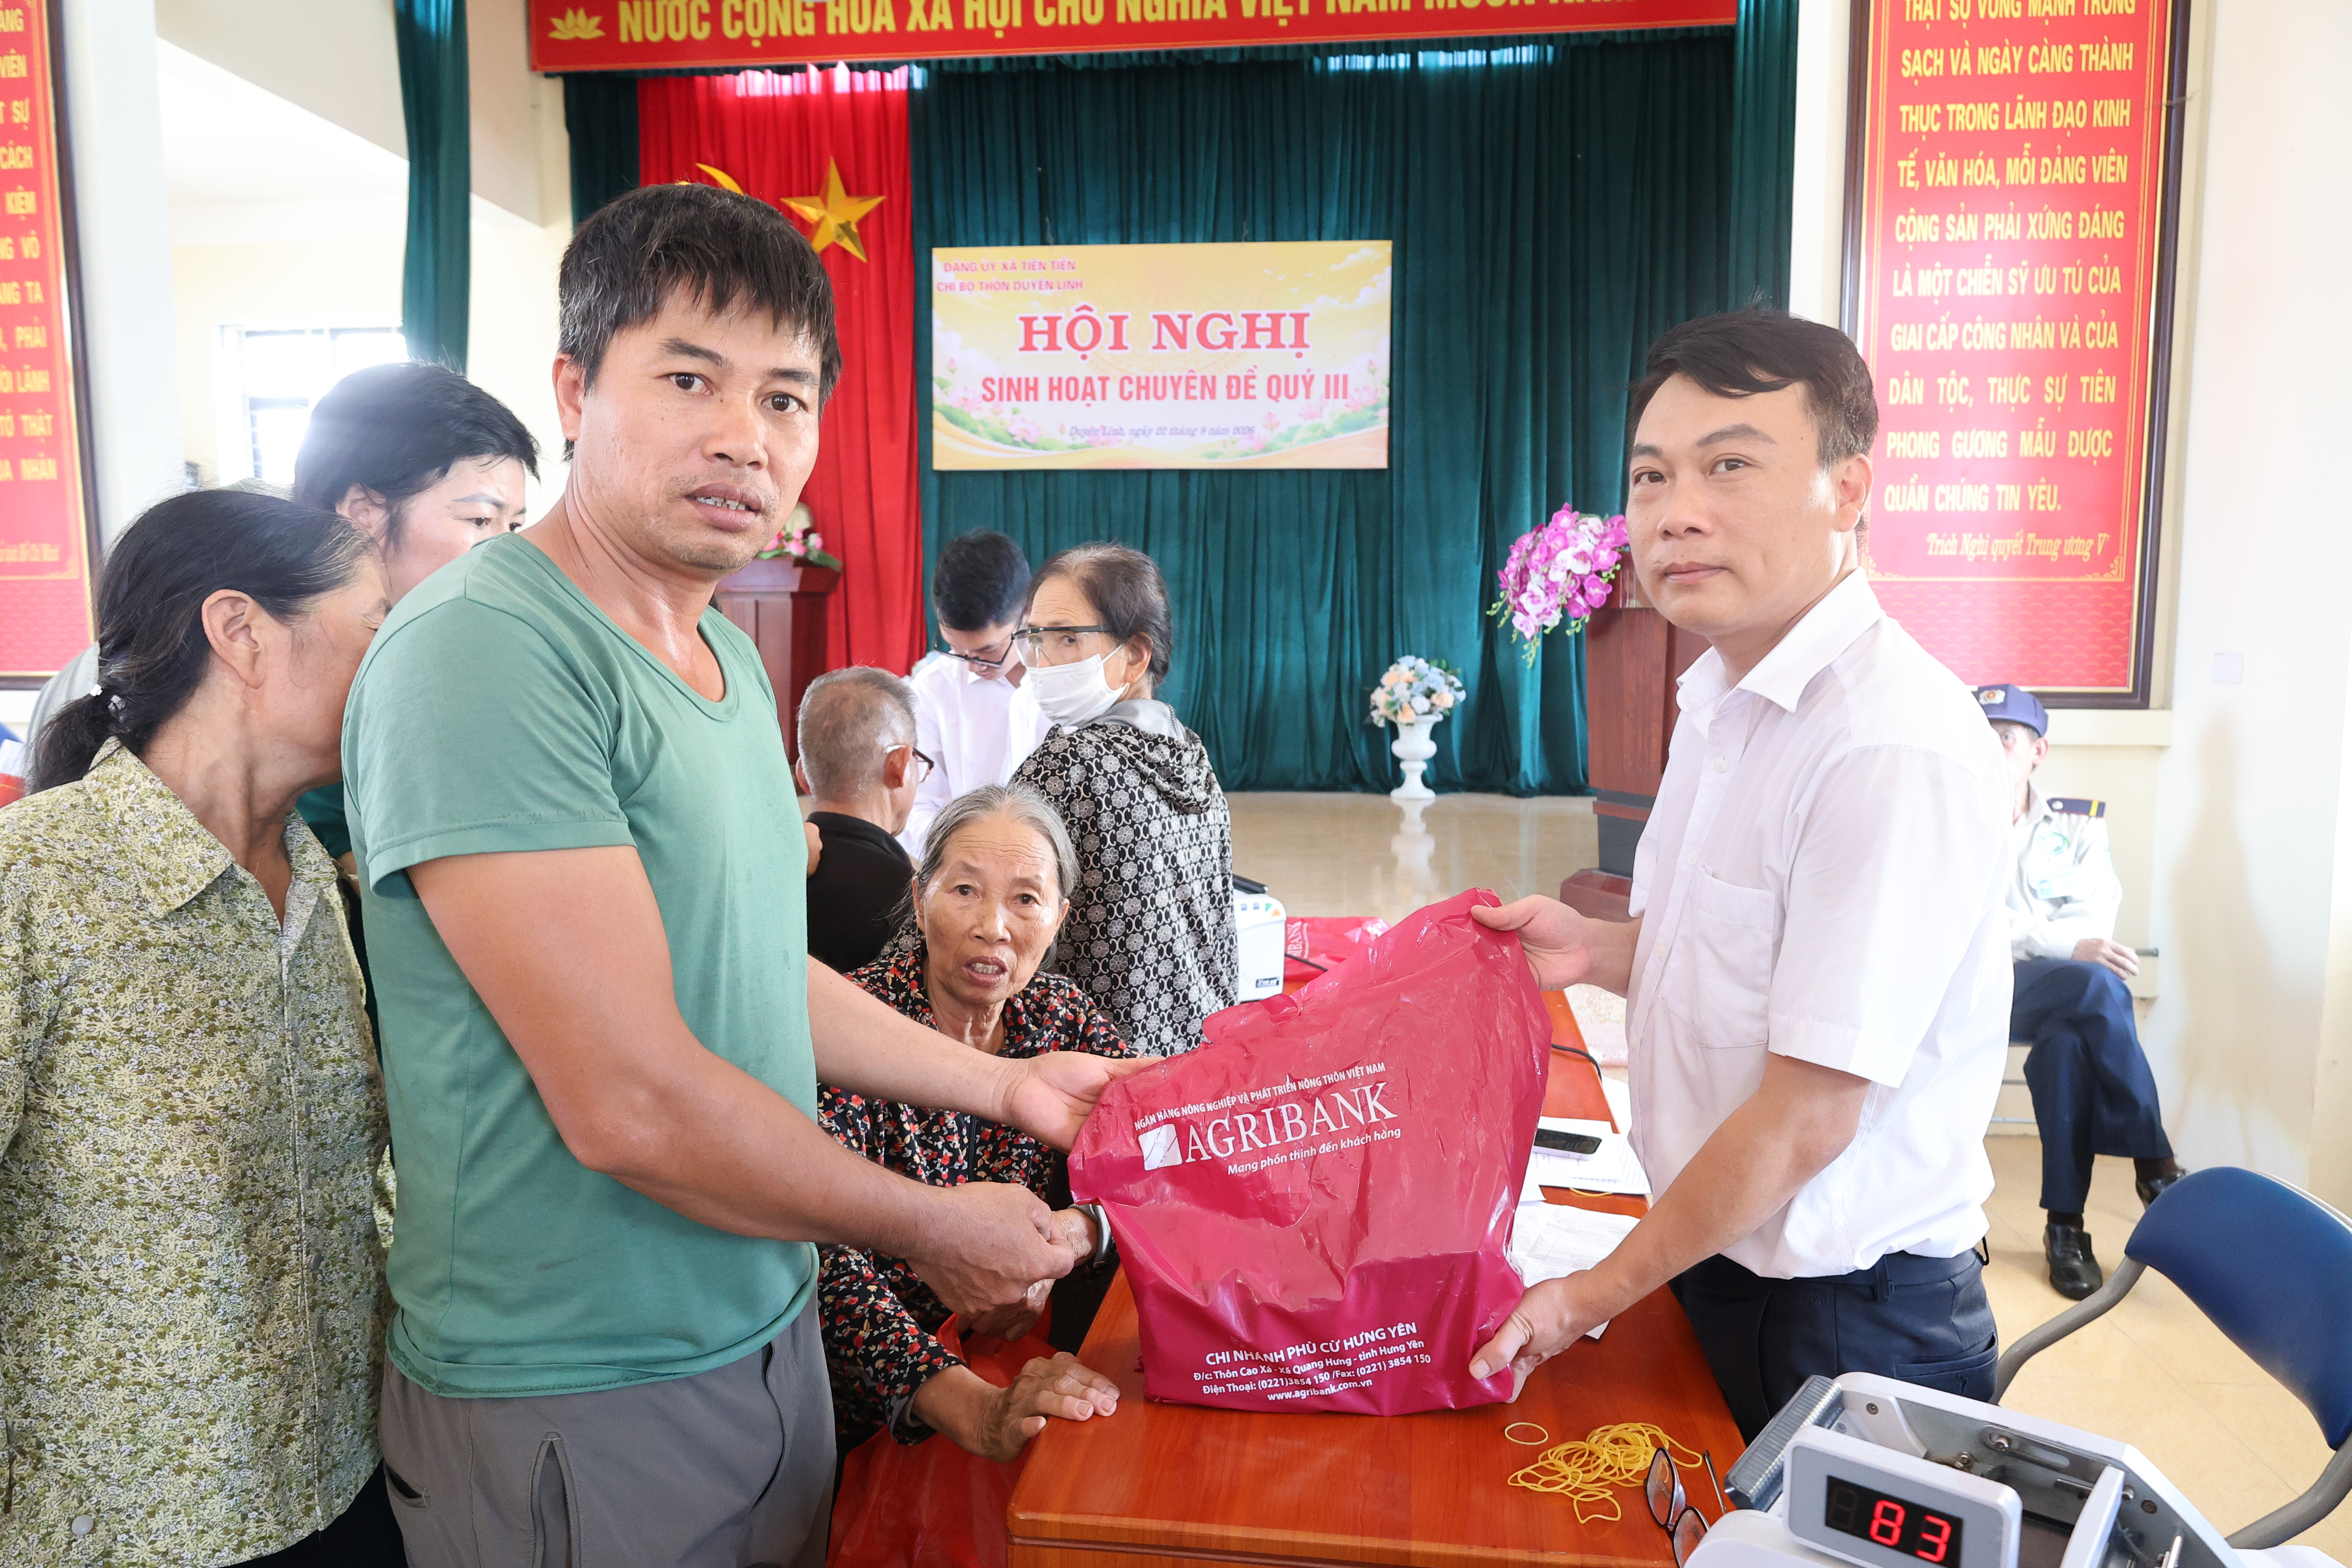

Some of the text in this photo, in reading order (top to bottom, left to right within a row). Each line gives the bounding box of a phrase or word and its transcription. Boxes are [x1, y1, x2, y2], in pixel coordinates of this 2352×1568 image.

[1901, 35, 2134, 85] SẠCH VÀ NGÀY CÀNG THÀNH
[1900, 94, 2131, 141] THỤC TRONG LÃNH ĐẠO KINH
[1898, 143, 2129, 191] TẾ, VĂN HÓA, MỖI ĐẢNG VIÊN
[1895, 201, 2125, 251] CỘNG SẢN PHẢI XỨNG ĐÁNG
[25, 281, 44, 303] TA
[937, 281, 956, 291] CHI
[1057, 279, 1083, 290] LINH
[1893, 261, 1913, 297] LÀ
[1918, 261, 1952, 305] MỘT
[2008, 260, 2029, 295] SỸ
[2034, 263, 2057, 294] ƯU
[2062, 259, 2083, 294] TÚ
[2088, 253, 2122, 294] CỦA
[1018, 304, 1310, 361] HỘI NGHỊ
[1891, 309, 2119, 351] GIAI CẤP CÔNG NHÂN VÀ CỦA
[982, 365, 1348, 407] SINH HOẠT CHUYÊN ĐỀ QUÝ III
[1889, 368, 2116, 412] DÂN TỘC, THỰC SỰ TIÊN
[1886, 417, 2113, 466] PHONG GƯƠNG MẪU ĐƯỢC
[1884, 474, 2061, 512] QUẦN CHÚNG TIN YÊU.
[1959, 532, 1990, 562] Nghị
[1991, 528, 2024, 562] quyết
[2026, 532, 2062, 562] Trung
[2063, 535, 2094, 563] ương
[1134, 1114, 1157, 1131] NGÂN
[1156, 1108, 1180, 1121] HÀNG
[1181, 1103, 1205, 1116] NÔNG
[1206, 1096, 1236, 1109] NGHIỆP
[1237, 1092, 1250, 1104] VÀ
[1250, 1087, 1272, 1101] PHÁT
[1298, 1076, 1322, 1091] NÔNG
[1322, 1071, 1346, 1085] THÔN
[1345, 1065, 1364, 1079] VIỆT
[1365, 1062, 1386, 1074] NAM
[1185, 1082, 1397, 1163] AGRIBANK
[1228, 1128, 1401, 1175] Mang phồn thịnh đến khách hàng
[1193, 1372, 1213, 1381] Đ/c:
[1213, 1369, 1238, 1379] Thôn
[1240, 1367, 1258, 1376] Cao
[1292, 1360, 1324, 1375] Quang
[1325, 1357, 1352, 1367] Hưng
[1359, 1348, 1378, 1361] tỉnh
[1379, 1345, 1406, 1356] Hưng
[1406, 1340, 1425, 1350] Yên
[1205, 1322, 1417, 1365] CHI NHÁNH PHÙ CỪ HƯNG YÊN
[1203, 1385, 1225, 1395] Điện
[1226, 1381, 1256, 1392] Thoại:
[1313, 1372, 1330, 1385] 150
[1332, 1370, 1355, 1379] /Fax:
[1356, 1361, 1387, 1377] (0221)
[1388, 1355, 1412, 1369] 3854
[1414, 1354, 1431, 1363] 150
[1267, 1379, 1373, 1401] www.agribank.com.vn
[1869, 1500, 1952, 1563] 83
